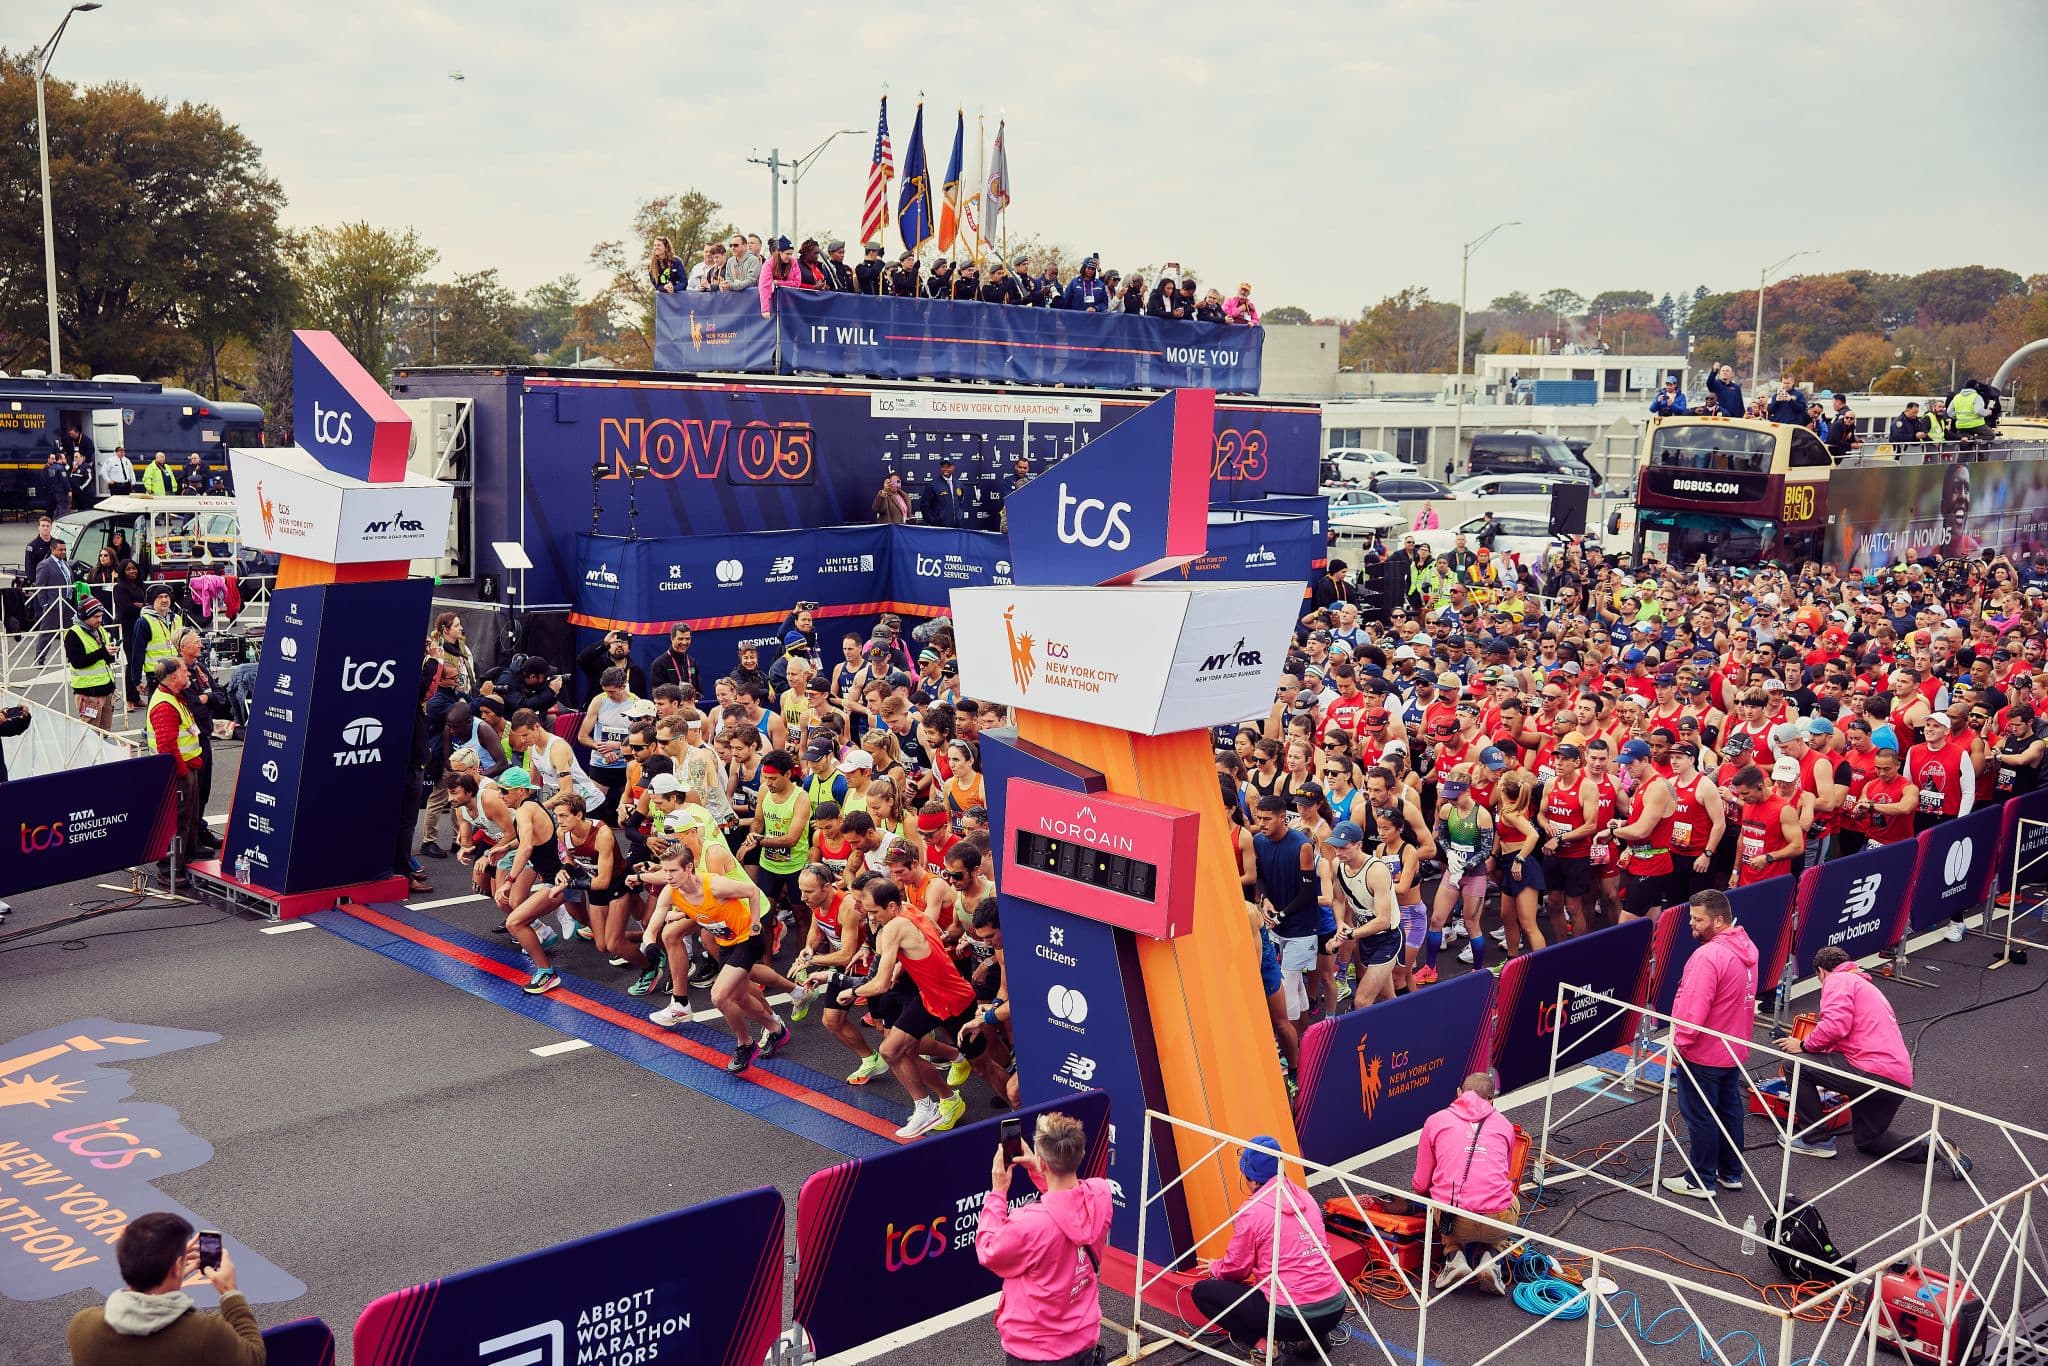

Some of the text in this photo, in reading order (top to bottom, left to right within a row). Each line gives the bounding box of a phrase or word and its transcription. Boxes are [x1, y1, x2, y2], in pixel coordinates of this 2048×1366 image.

[811, 326, 879, 346] IT WILL
[1166, 347, 1239, 366] MOVE YOU
[880, 398, 894, 411] tcs
[932, 401, 1059, 415] tcs NEW YORK CITY MARATHON
[23, 420, 46, 428] UNIT
[314, 400, 353, 446] tcs
[600, 417, 812, 480] NOV 05
[1212, 429, 1268, 480] 23
[1673, 479, 1739, 495] BIGBUS.COM
[1785, 486, 1802, 505] BIG
[1058, 482, 1132, 550] tcs
[1783, 504, 1801, 522] BUS
[363, 520, 425, 533] NYRR
[1860, 532, 1896, 554] WATCH
[1899, 530, 1910, 550] IT
[1913, 528, 1936, 548] NOV
[817, 564, 858, 573] AIRLINES
[825, 557, 858, 565] UNITED
[916, 553, 942, 577] tcs
[943, 562, 983, 573] CONSULTANCY
[945, 555, 962, 563] TATA
[776, 574, 799, 582] balance
[943, 571, 970, 580] SERVICES
[992, 576, 1012, 585] TATA
[660, 581, 692, 591] Citizens
[1047, 638, 1069, 659] tcs
[1199, 650, 1263, 671] NYRR
[341, 656, 397, 692] tcs
[1046, 661, 1119, 684] NEW YORK CITY
[1237, 669, 1261, 677] RUNNERS
[1045, 675, 1100, 694] MARATHON
[333, 748, 382, 767] TATA
[1438, 771, 1449, 780] FD
[1598, 799, 1611, 807] NY
[1677, 804, 1688, 812] NY
[68, 808, 95, 822] TATA
[68, 812, 129, 833] CONSULTANCY
[20, 821, 65, 854] tcs
[68, 828, 108, 845] SERVICES
[1040, 816, 1133, 852] NORQAIN
[1827, 918, 1881, 948] new balance
[1035, 943, 1078, 967] Citizens
[1570, 1006, 1598, 1025] SERVICES
[1048, 1016, 1086, 1036] mastercard
[1391, 1051, 1409, 1070] tcs
[1053, 1073, 1068, 1084] new
[1389, 1056, 1445, 1086] NEW YORK CITY
[1388, 1075, 1430, 1098] MARATHON
[52, 1117, 162, 1170] tcs
[885, 1216, 947, 1272] tcs
[576, 1288, 655, 1328] ABBOTT
[1902, 1295, 1926, 1308] HONDA
[576, 1310, 648, 1346] WORLD
[577, 1313, 691, 1366] MARATHON
[588, 1342, 658, 1366] JORS
